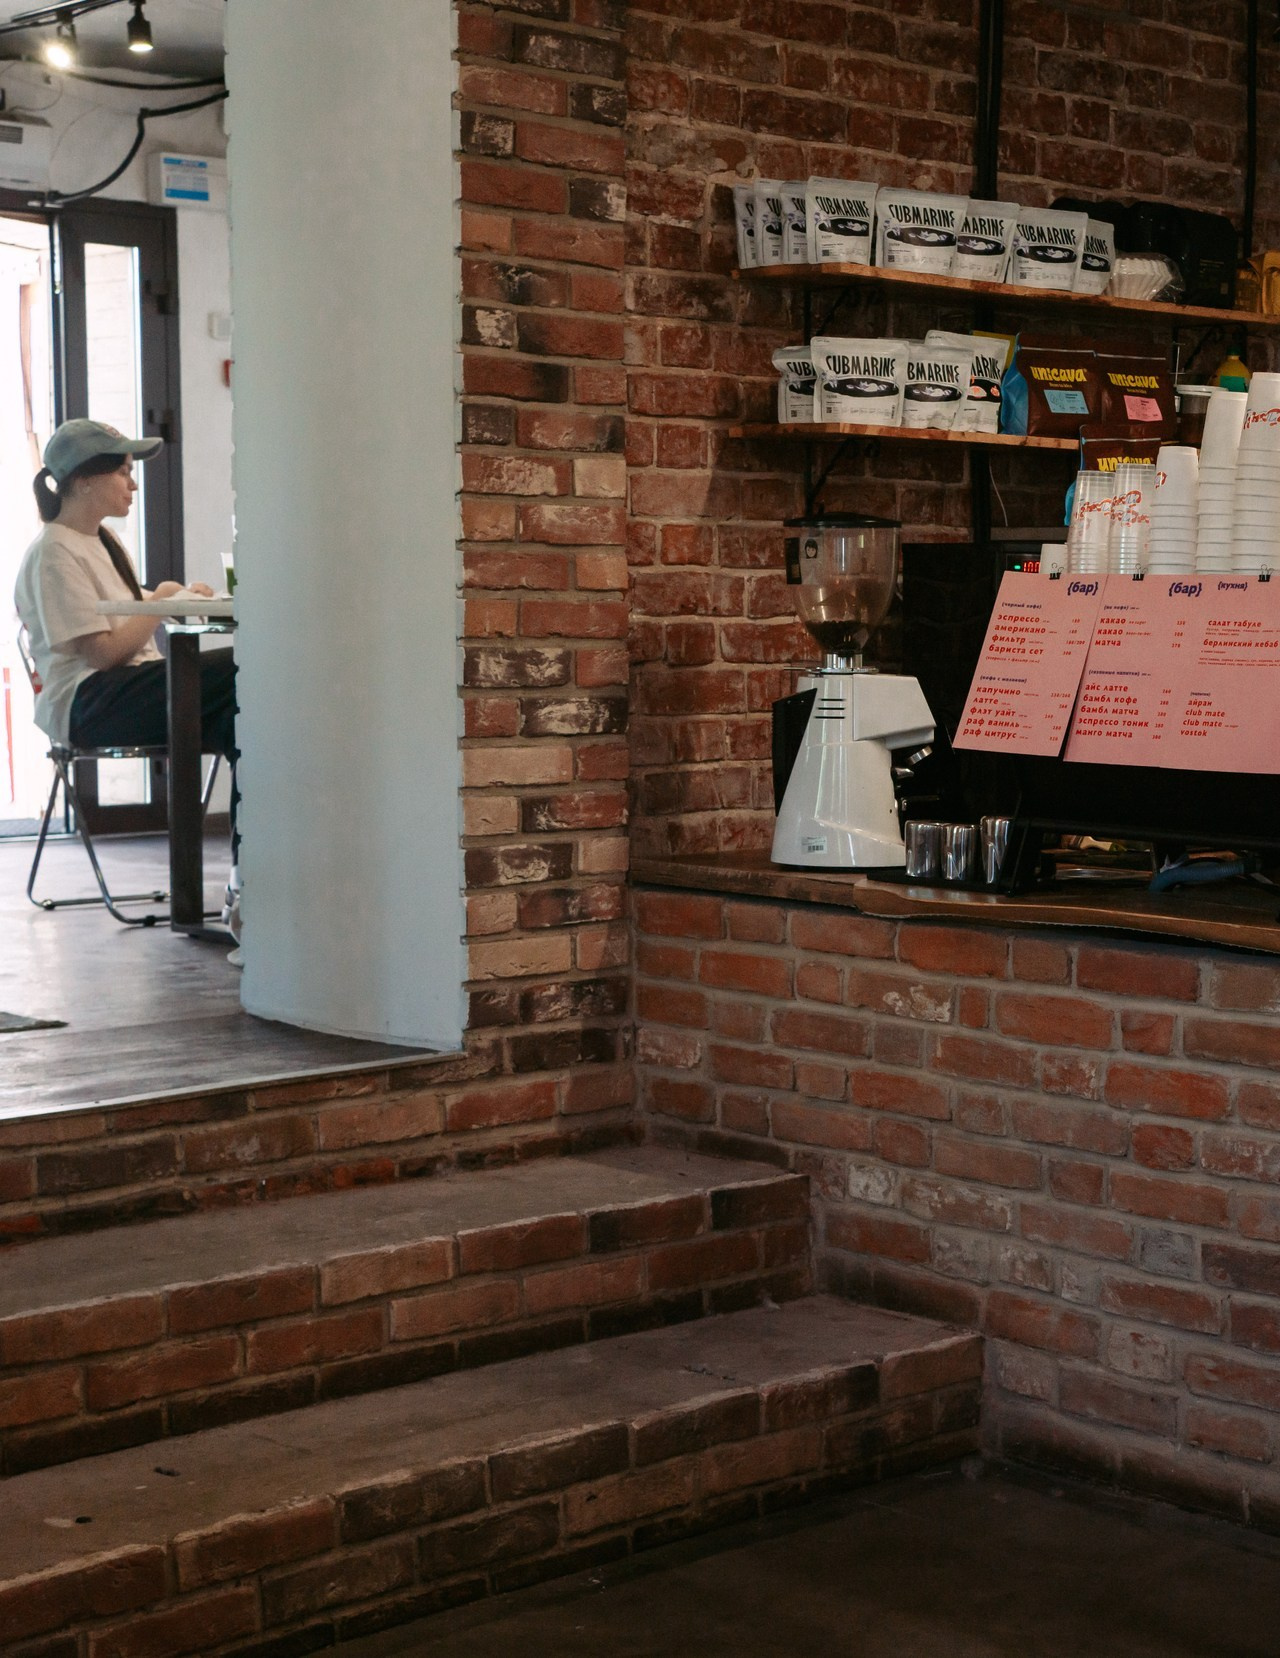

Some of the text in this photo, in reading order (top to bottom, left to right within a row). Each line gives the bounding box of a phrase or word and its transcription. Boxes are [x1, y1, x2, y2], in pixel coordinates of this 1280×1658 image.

[815, 196, 870, 217] SUBMARINE
[888, 204, 955, 228] SUBMARINE
[961, 217, 1004, 237] MARINE
[1016, 224, 1076, 245] SUBMARINE
[825, 355, 896, 377] SUBMARINE
[907, 362, 960, 383] BMARINE
[1030, 366, 1087, 382] unicava
[1107, 373, 1160, 389] unicava
[1067, 581, 1099, 596] {бар}
[1168, 582, 1202, 597] {бар}
[997, 613, 1040, 623] эспрессо
[995, 624, 1046, 634] американо
[1233, 620, 1262, 628] табуле
[991, 633, 1026, 645] фильтр
[1203, 639, 1252, 648] берлинский
[988, 644, 1026, 654] бариста
[976, 686, 1021, 696] капучино
[1085, 683, 1100, 691] айс
[1083, 693, 1111, 702] бамбл
[1114, 696, 1137, 705] кофе
[1188, 699, 1212, 708] айран
[970, 706, 992, 715] флэт
[995, 708, 1016, 717] уайт
[1081, 705, 1108, 714] бамбл
[966, 718, 985, 726] раф
[988, 719, 1020, 728] ваниль
[1078, 717, 1119, 727] эспрессо
[963, 728, 981, 737] раф
[984, 730, 1017, 739] цитрус
[1180, 729, 1207, 737] vostok
